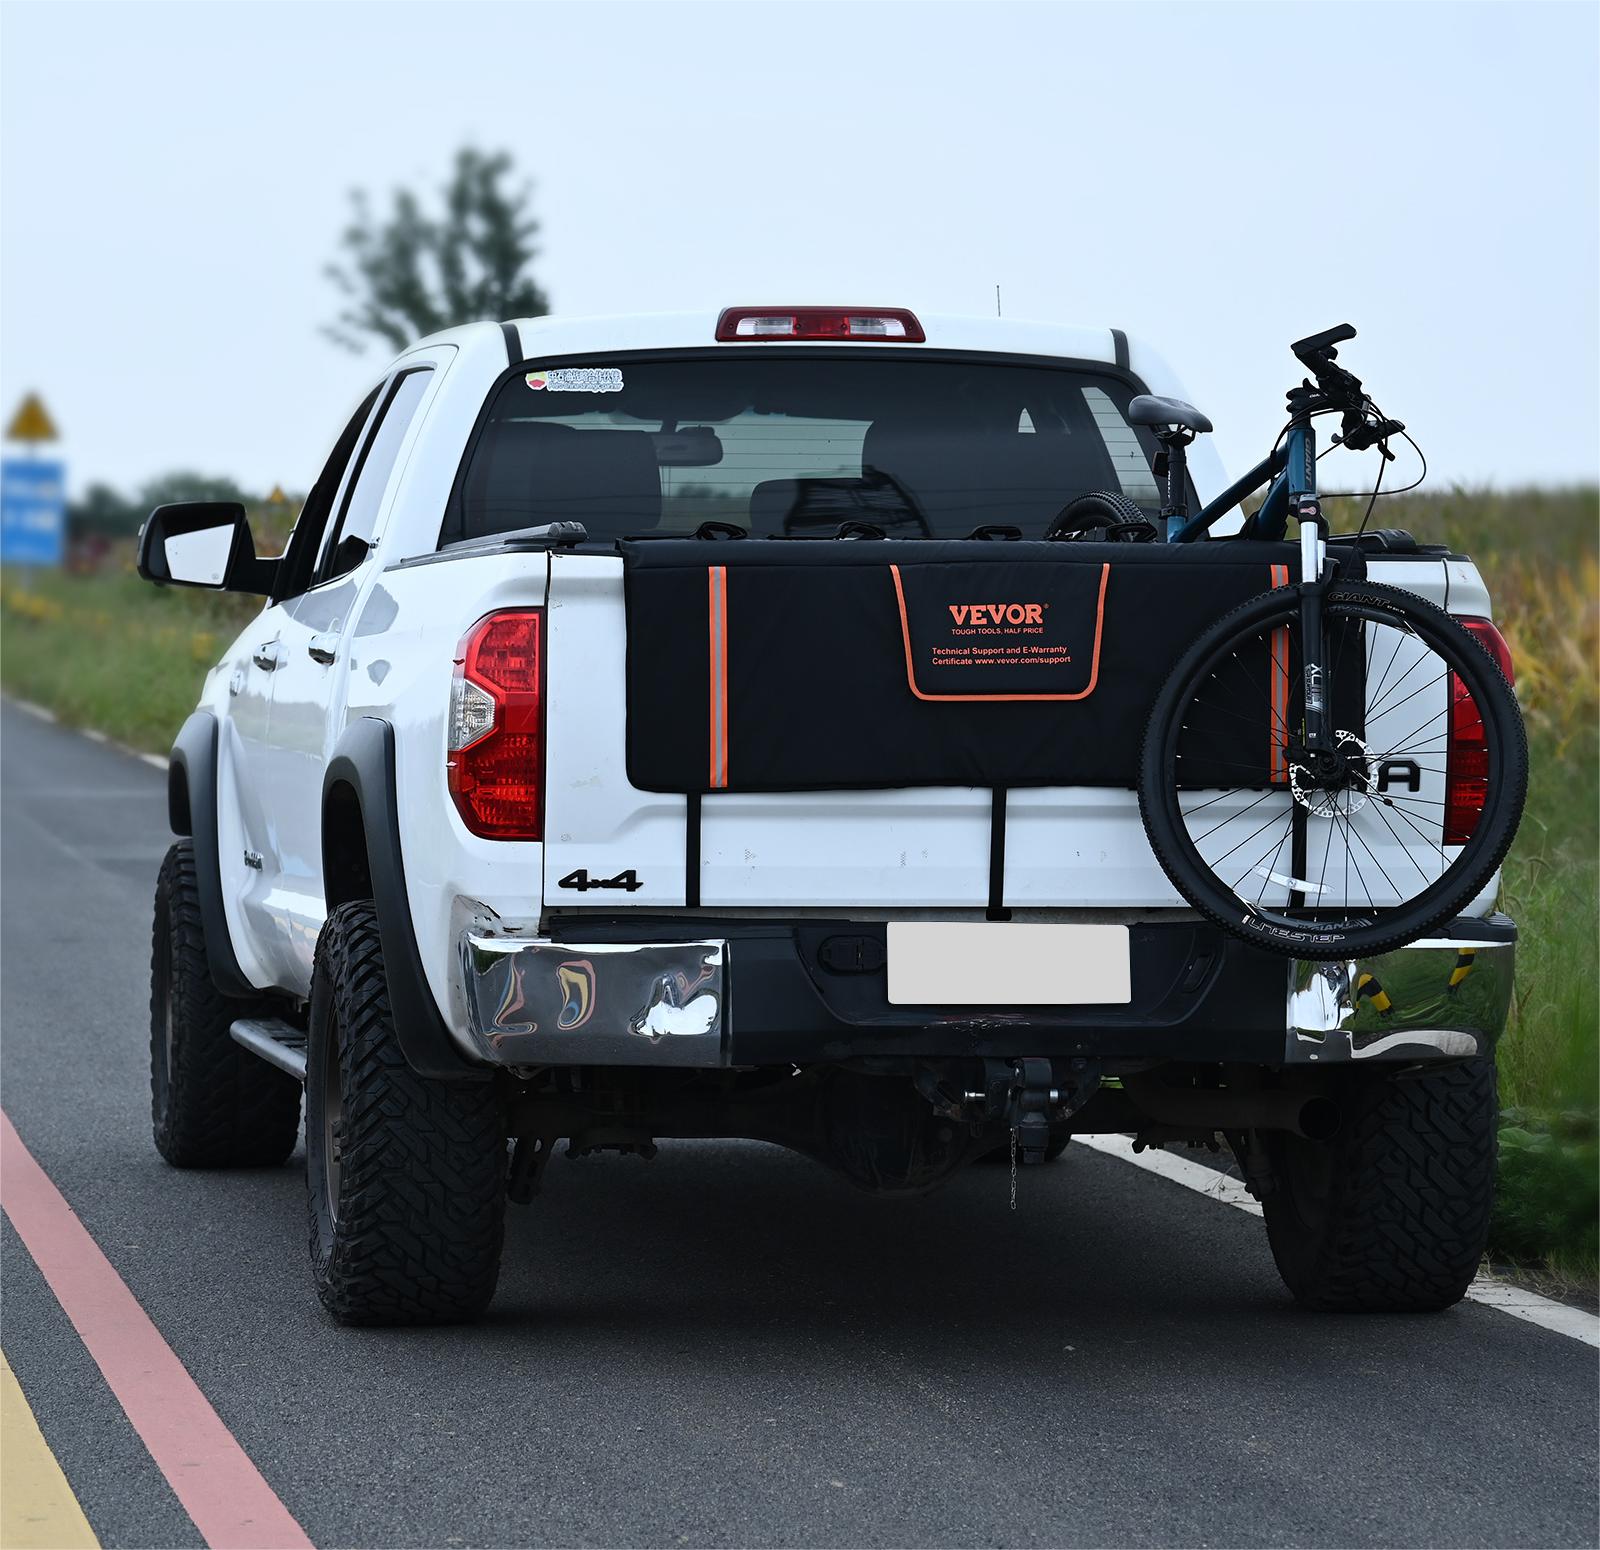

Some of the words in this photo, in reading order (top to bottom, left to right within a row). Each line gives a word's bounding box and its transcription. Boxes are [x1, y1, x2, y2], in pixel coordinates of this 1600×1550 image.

[1304, 438, 1312, 481] GIANT
[1328, 592, 1390, 608] GIANT
[949, 604, 1043, 625] VEVOR
[932, 647, 970, 655] Technical
[972, 646, 1004, 656] Support
[1006, 646, 1021, 654] and
[1023, 646, 1067, 655] E-Warranty
[932, 657, 972, 665] Certificate
[974, 656, 1071, 665] www.vevor.com/support
